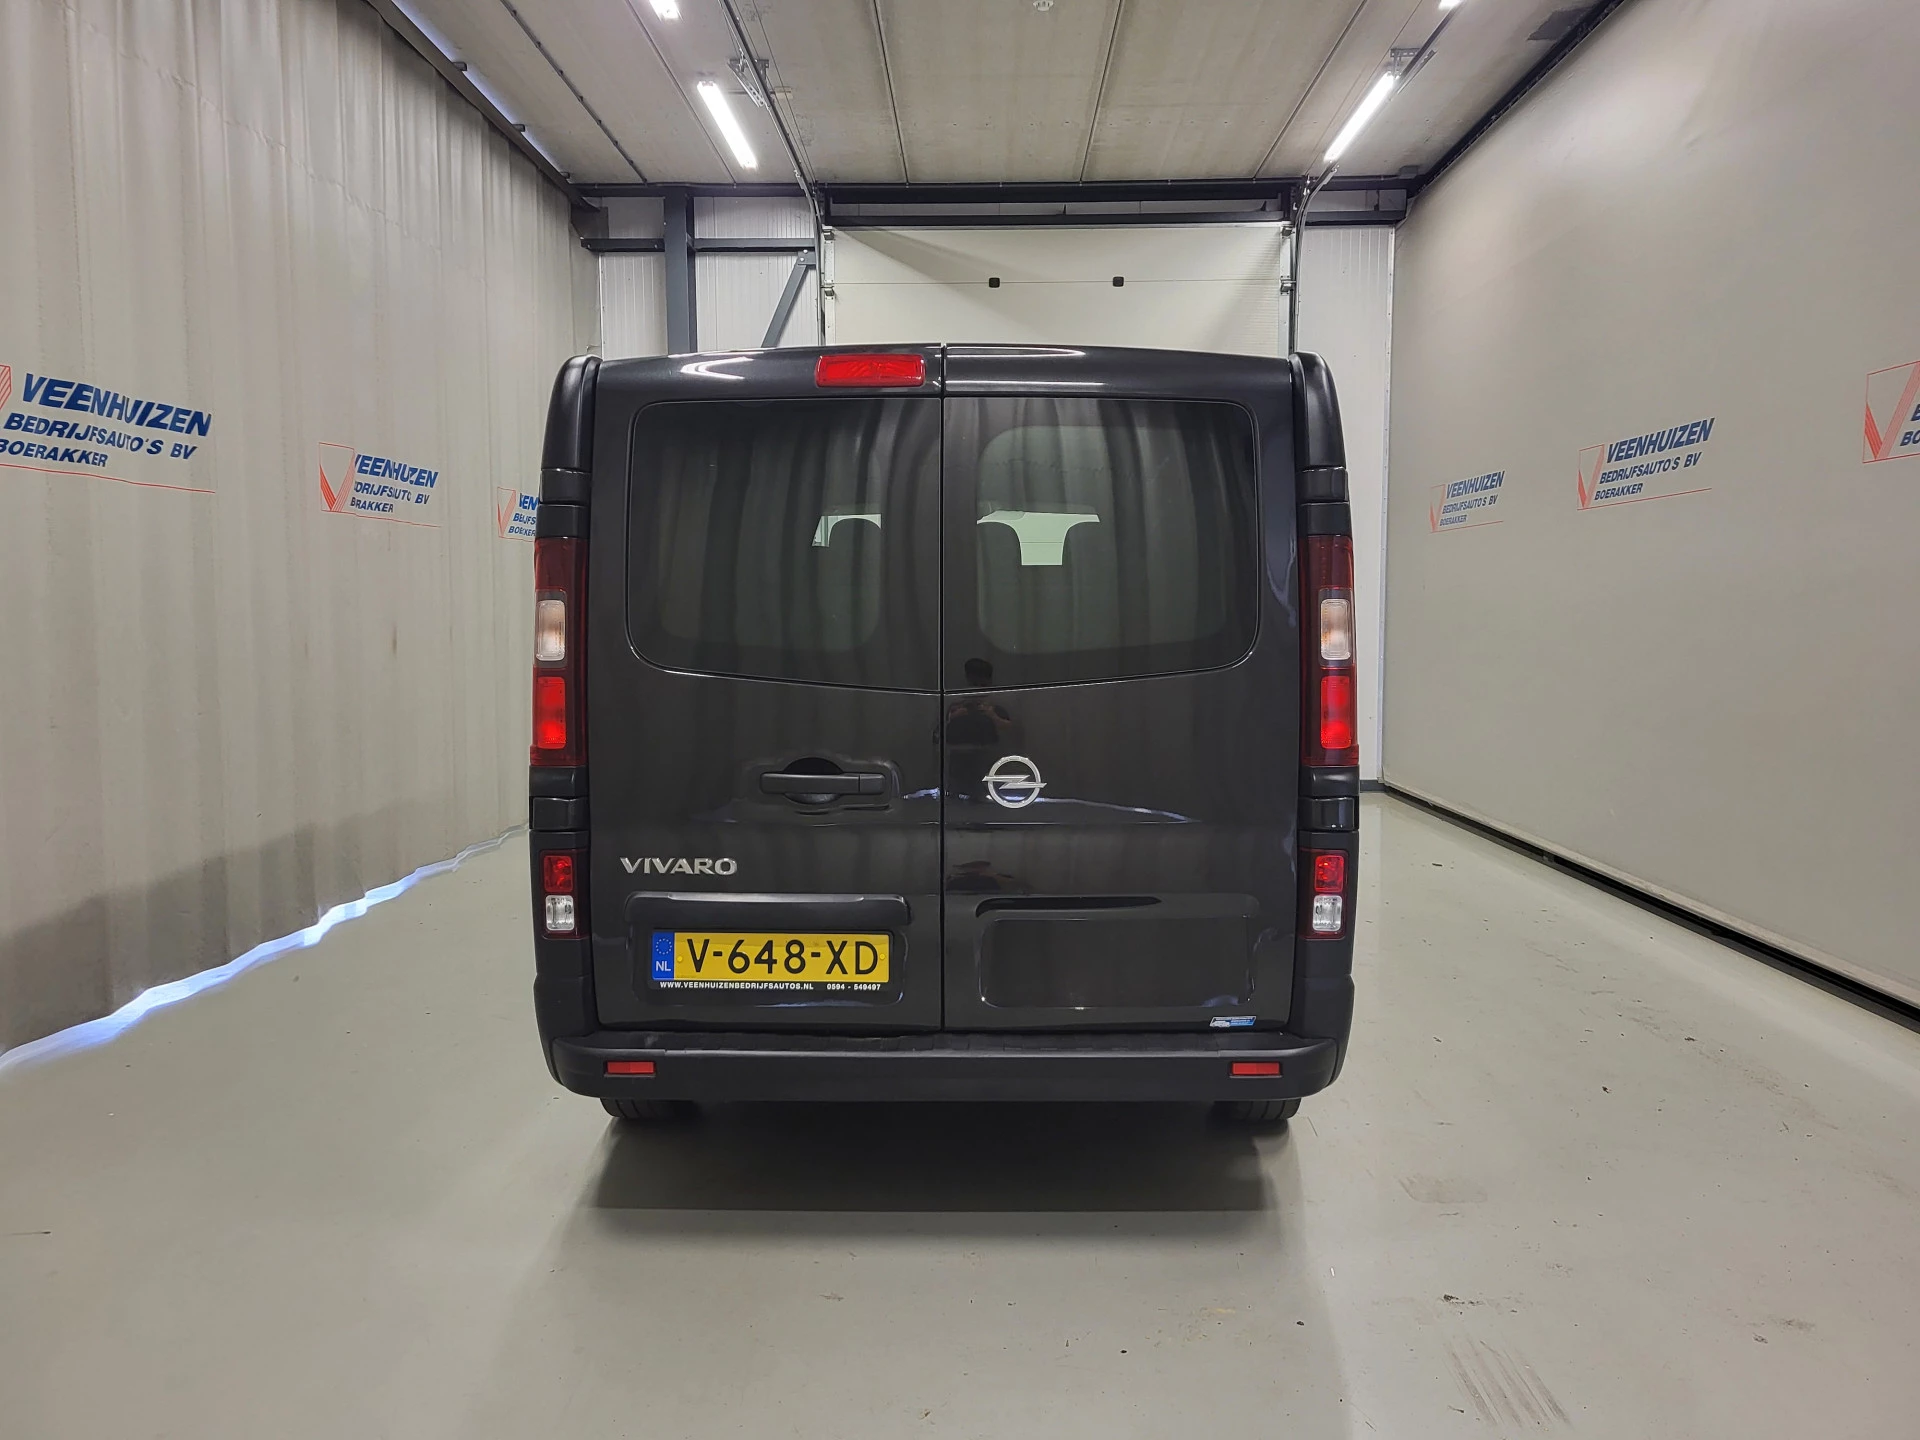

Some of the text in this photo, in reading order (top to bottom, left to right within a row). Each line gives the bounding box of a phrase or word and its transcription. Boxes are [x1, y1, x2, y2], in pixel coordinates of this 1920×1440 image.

[22, 373, 212, 437] VEENHUIZEN
[4, 412, 198, 460] BEDRIJFSAUTO'S BV
[1606, 417, 1715, 463] VEENHUIZEN
[1599, 452, 1702, 484] BEDRIJFSAUTO'S BV
[414, 493, 430, 505] BV
[1446, 470, 1505, 499] VEENHUIZEN
[1594, 482, 1643, 501] BOERAKKER
[1488, 494, 1498, 506] BV
[620, 857, 737, 875] VIVARO
[655, 939, 878, 976] NL V-648-XD
[660, 981, 814, 990] WWW.VEENHUIZENBEDRIJFSAUTOS.NL
